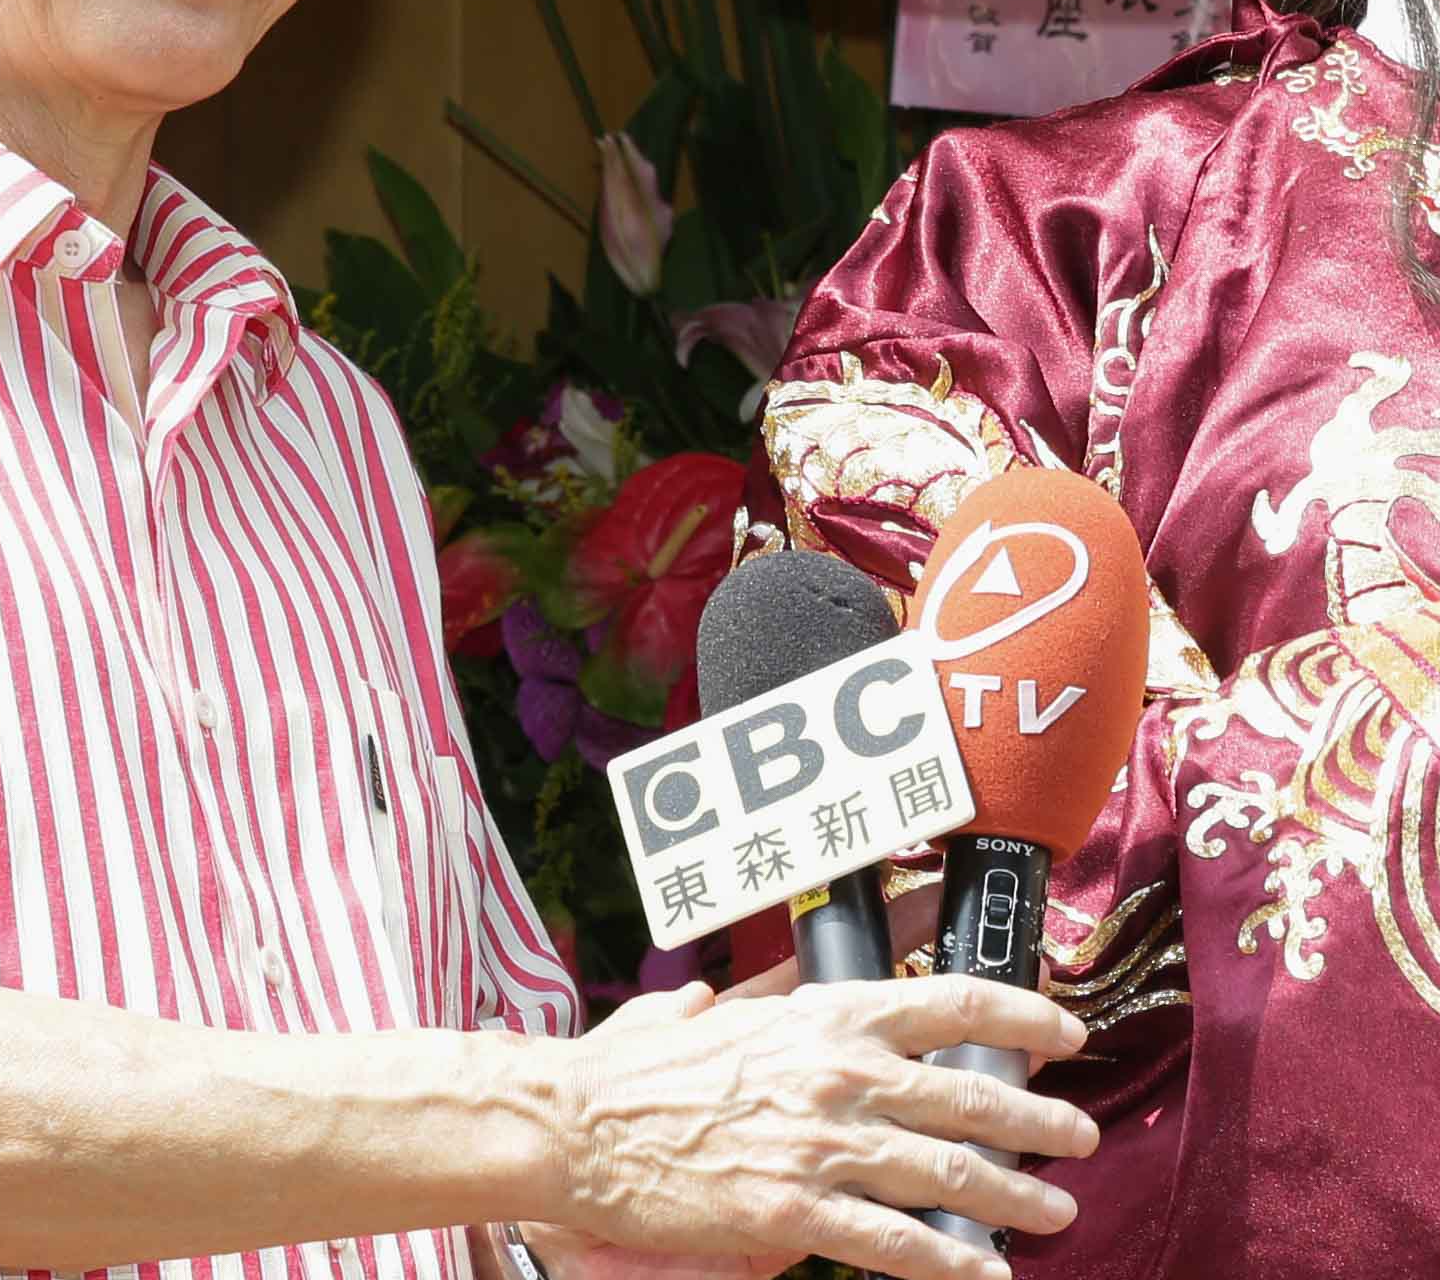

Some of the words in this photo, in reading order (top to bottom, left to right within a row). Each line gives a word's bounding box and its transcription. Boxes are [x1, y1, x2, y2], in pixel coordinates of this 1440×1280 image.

[948, 672, 1087, 736] TV
[653, 757, 955, 929] 東森新聞
[975, 837, 1037, 858] SONY
